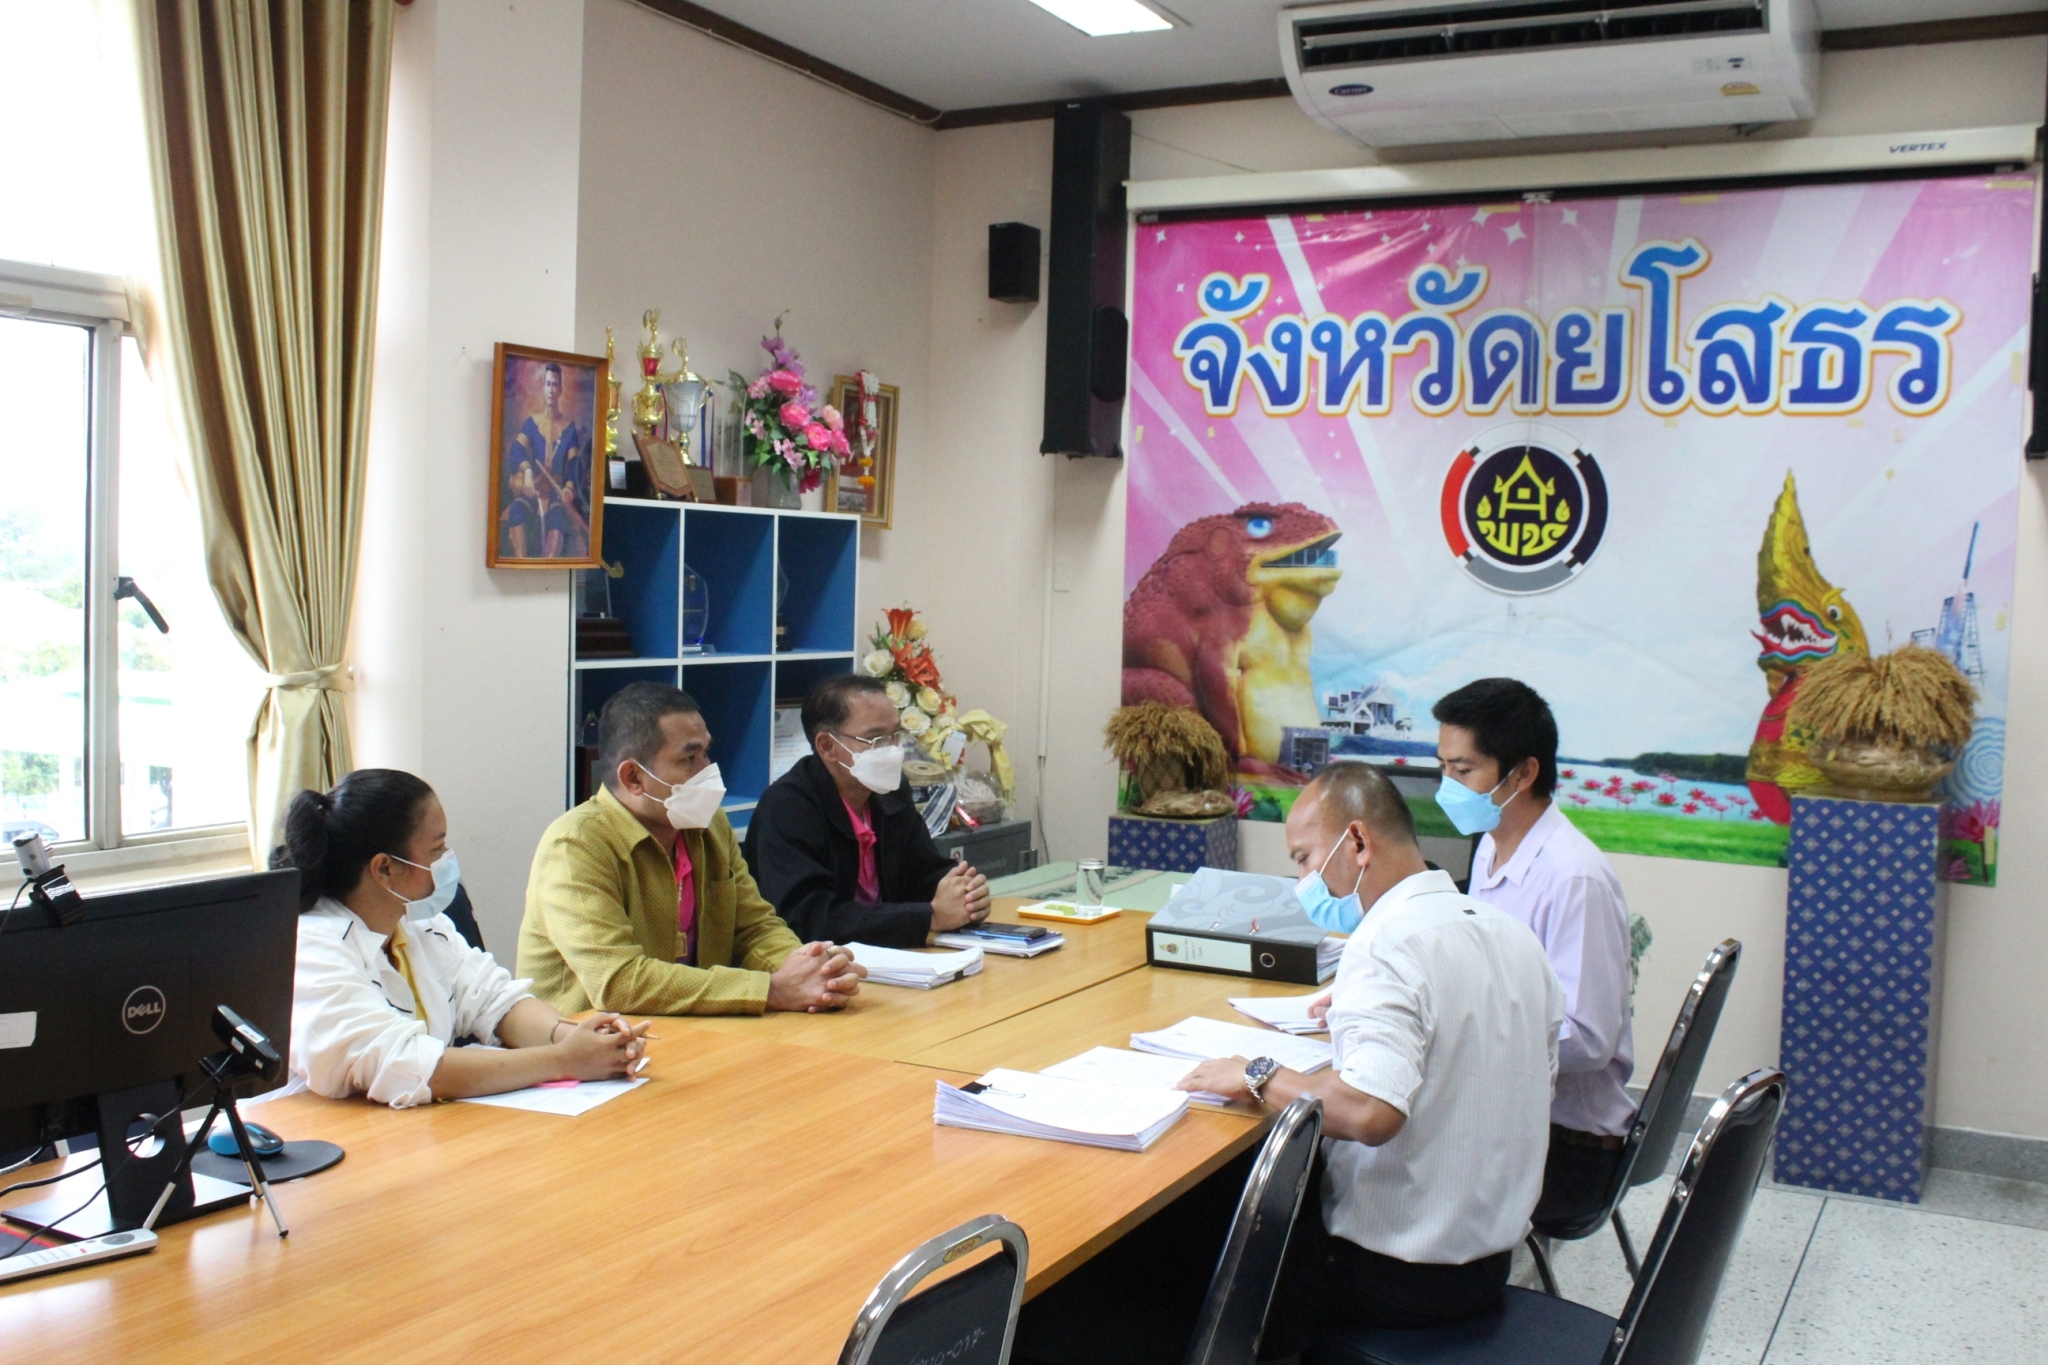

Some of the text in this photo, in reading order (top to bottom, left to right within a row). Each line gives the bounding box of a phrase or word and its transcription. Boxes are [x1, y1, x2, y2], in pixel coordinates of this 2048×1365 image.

[1889, 143, 1947, 153] VERTEX
[1176, 241, 1956, 411] จังหวัดยโสธร
[127, 1002, 161, 1018] DELL
